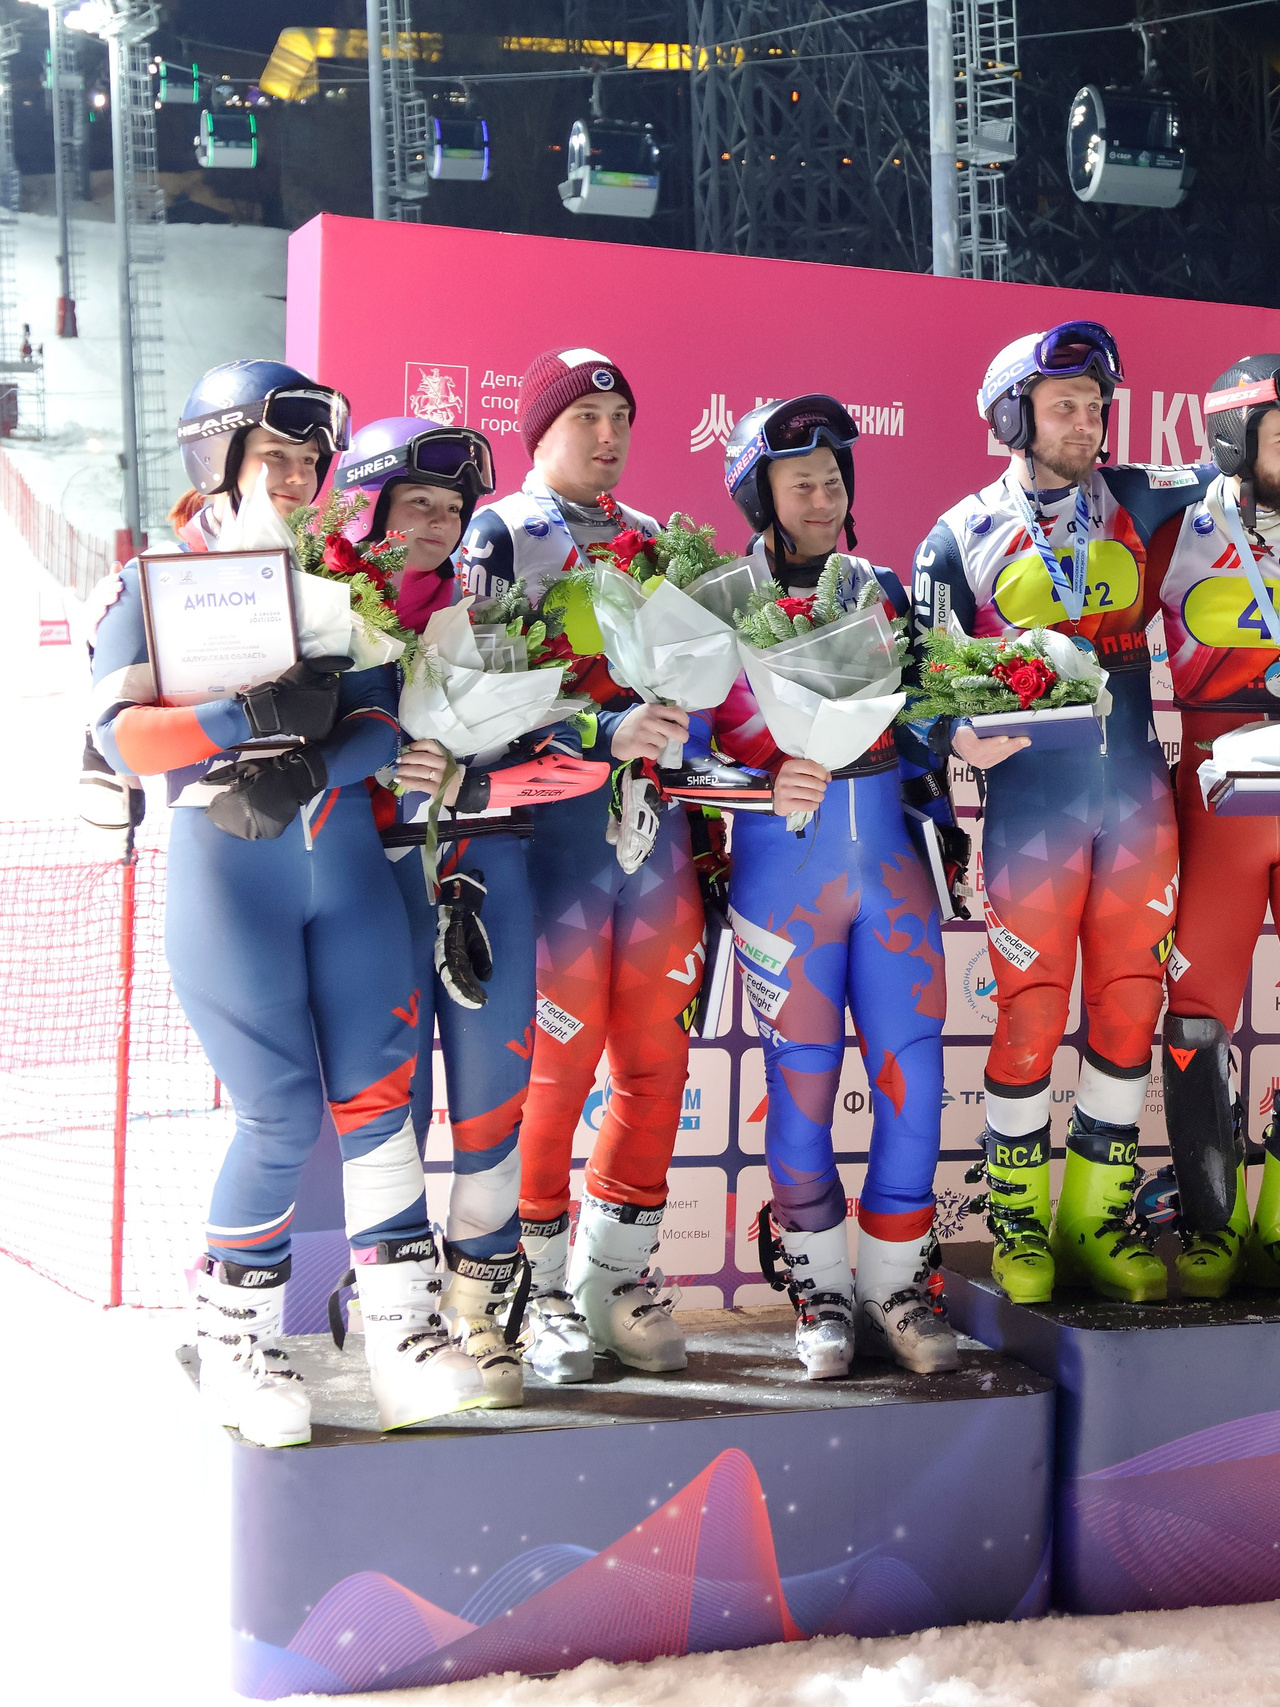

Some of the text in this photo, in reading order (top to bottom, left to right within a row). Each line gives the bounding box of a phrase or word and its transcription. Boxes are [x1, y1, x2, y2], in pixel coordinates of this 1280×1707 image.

[987, 362, 1025, 399] POC
[178, 411, 243, 437] HEAD
[1157, 477, 1198, 487] TATNEFT
[184, 591, 257, 611] ДИПЛОМ
[1098, 581, 1114, 607] 2
[994, 937, 1026, 967] Freight
[1000, 928, 1036, 960] Federal
[747, 973, 780, 1003] Federal
[963, 945, 989, 1010] НАЦИОНАЛЬНА
[746, 986, 772, 1012] Freight
[536, 1010, 567, 1040] Freight
[541, 1000, 580, 1031] Federal
[996, 1142, 1043, 1166] RC4
[1108, 1142, 1138, 1163] RC
[661, 1228, 711, 1239] Москвы
[456, 1259, 513, 1279] BOOSTER
